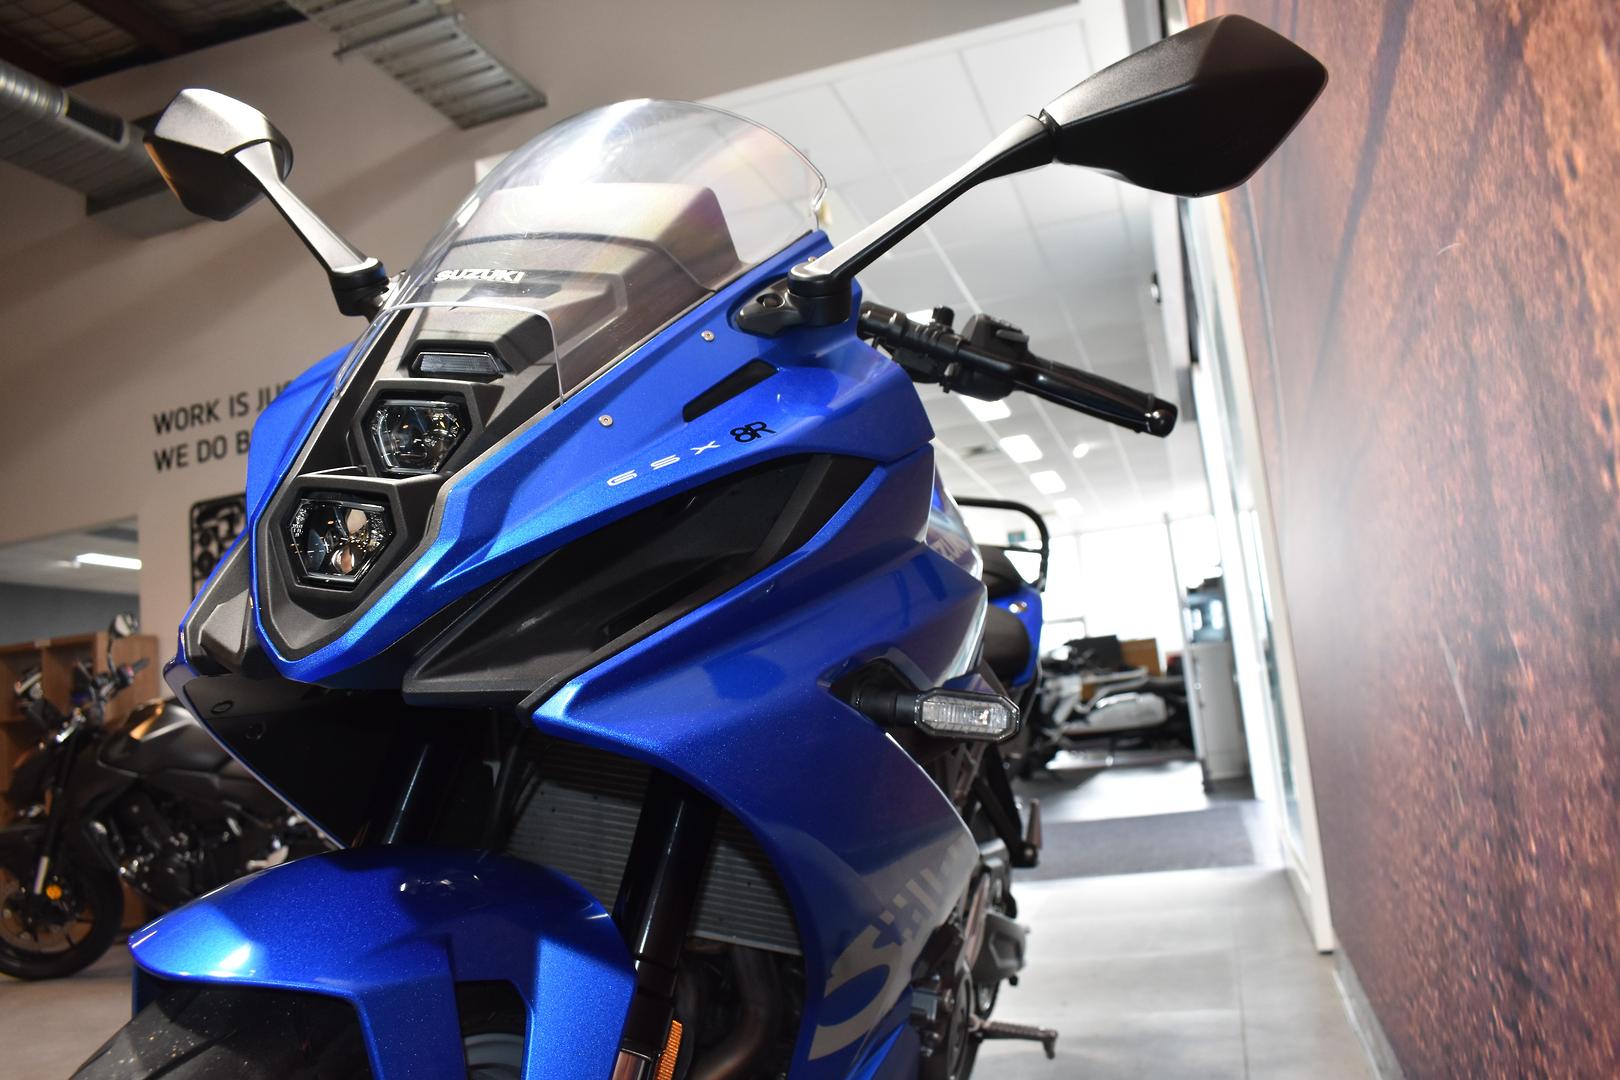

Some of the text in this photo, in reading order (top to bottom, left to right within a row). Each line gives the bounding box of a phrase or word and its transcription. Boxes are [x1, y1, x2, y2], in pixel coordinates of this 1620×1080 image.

[433, 268, 525, 284] SUZUKI
[152, 397, 220, 435] WORK
[229, 392, 249, 417] IS
[153, 443, 189, 472] WE
[196, 435, 227, 463] DO
